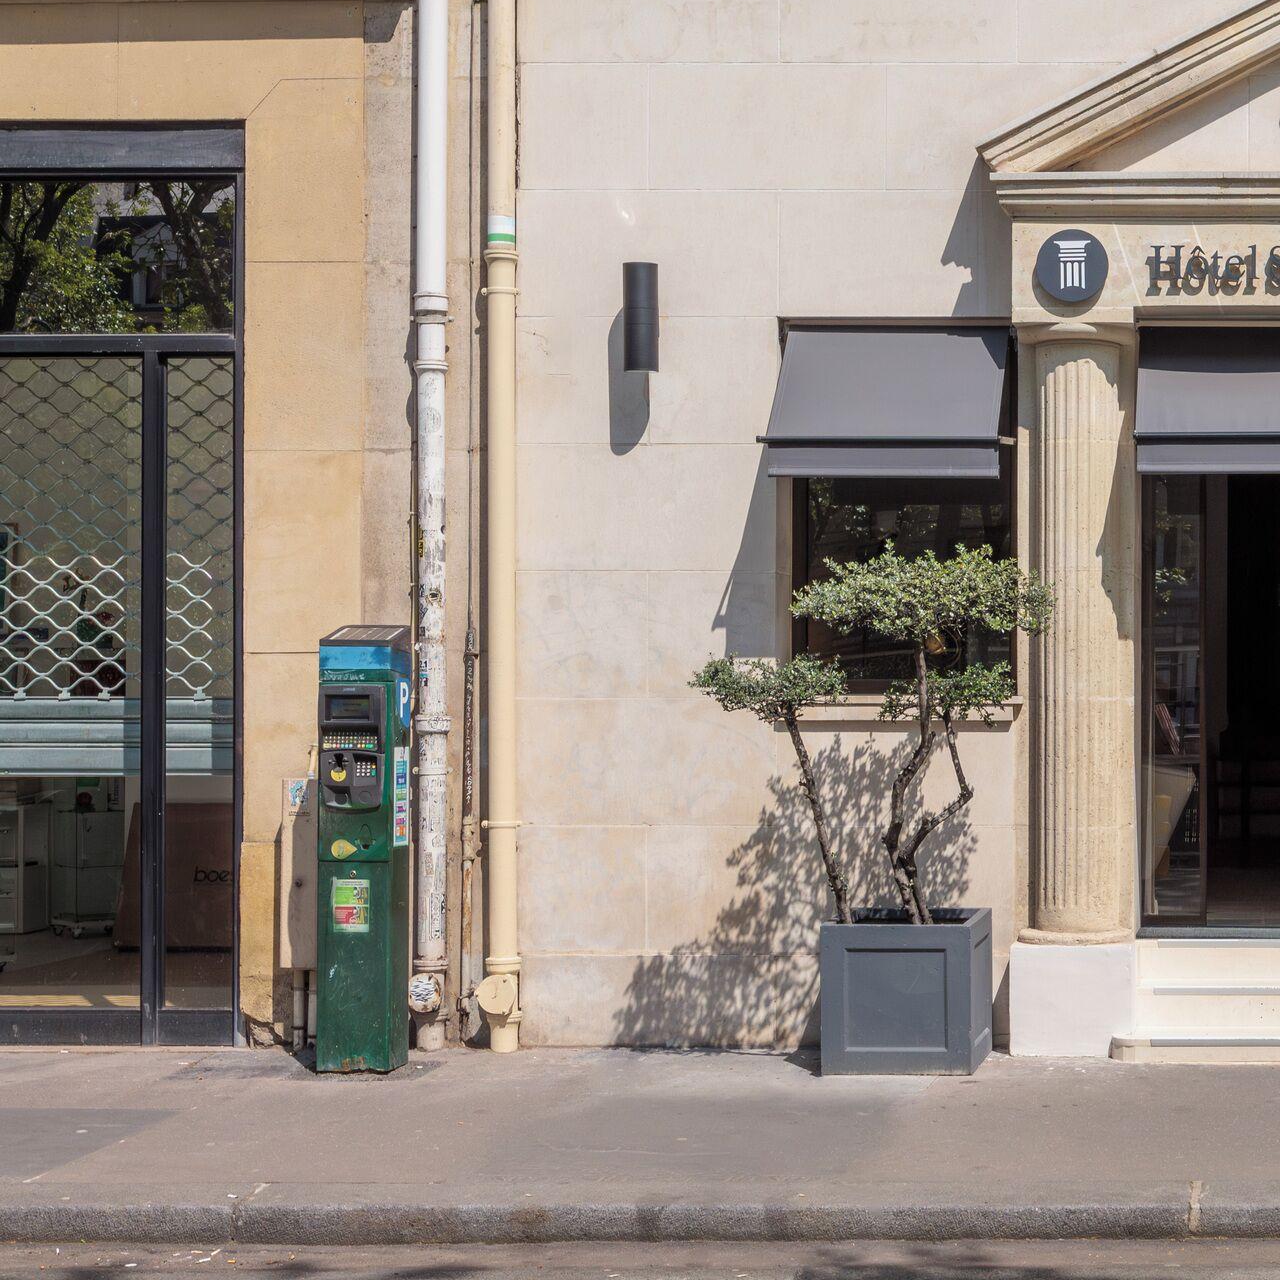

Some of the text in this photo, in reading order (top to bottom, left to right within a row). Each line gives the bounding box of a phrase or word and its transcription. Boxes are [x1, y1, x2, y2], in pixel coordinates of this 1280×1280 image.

[1150, 244, 1261, 281] Hôtel
[399, 681, 409, 719] P
[193, 865, 233, 883] boe
